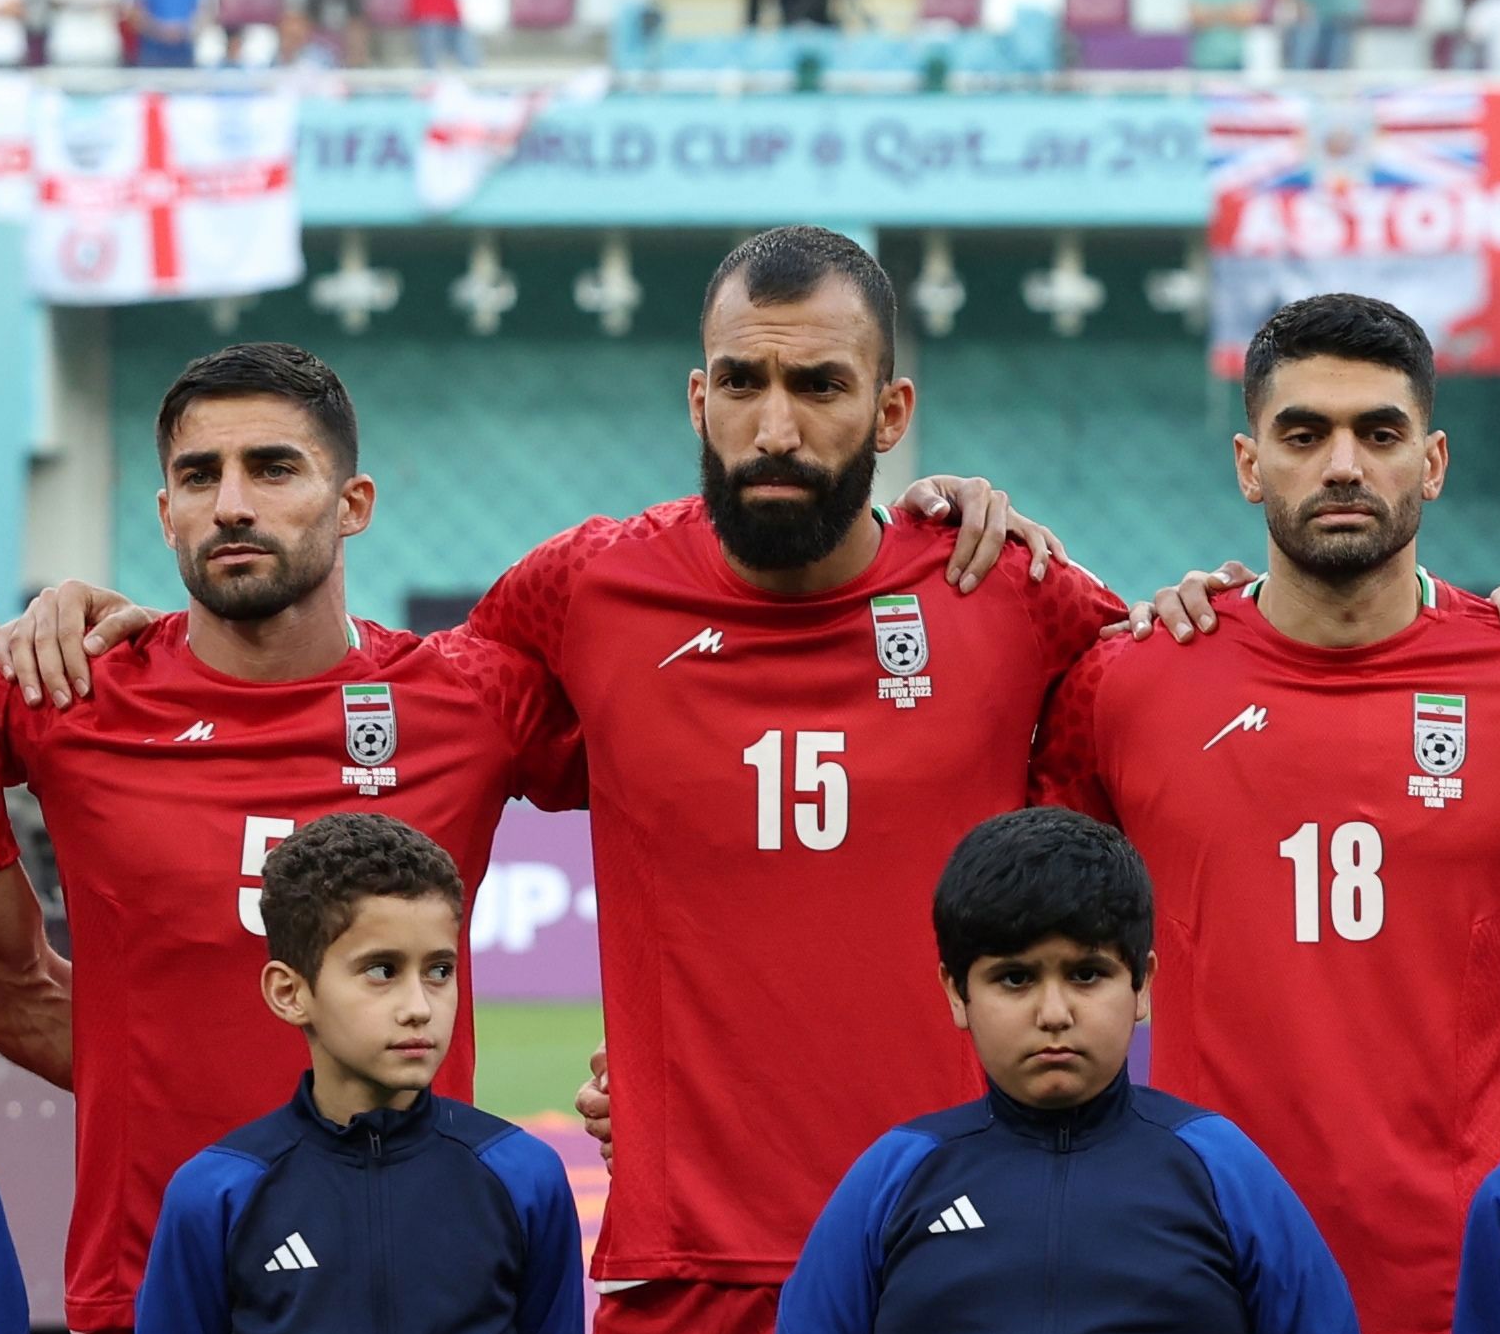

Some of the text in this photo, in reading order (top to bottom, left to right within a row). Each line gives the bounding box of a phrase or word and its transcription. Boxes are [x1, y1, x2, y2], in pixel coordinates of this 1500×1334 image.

[672, 123, 792, 177] CUP
[896, 698, 915, 708] DOHA
[743, 730, 849, 852] 15
[237, 815, 295, 936] 5
[1279, 821, 1384, 943] 18
